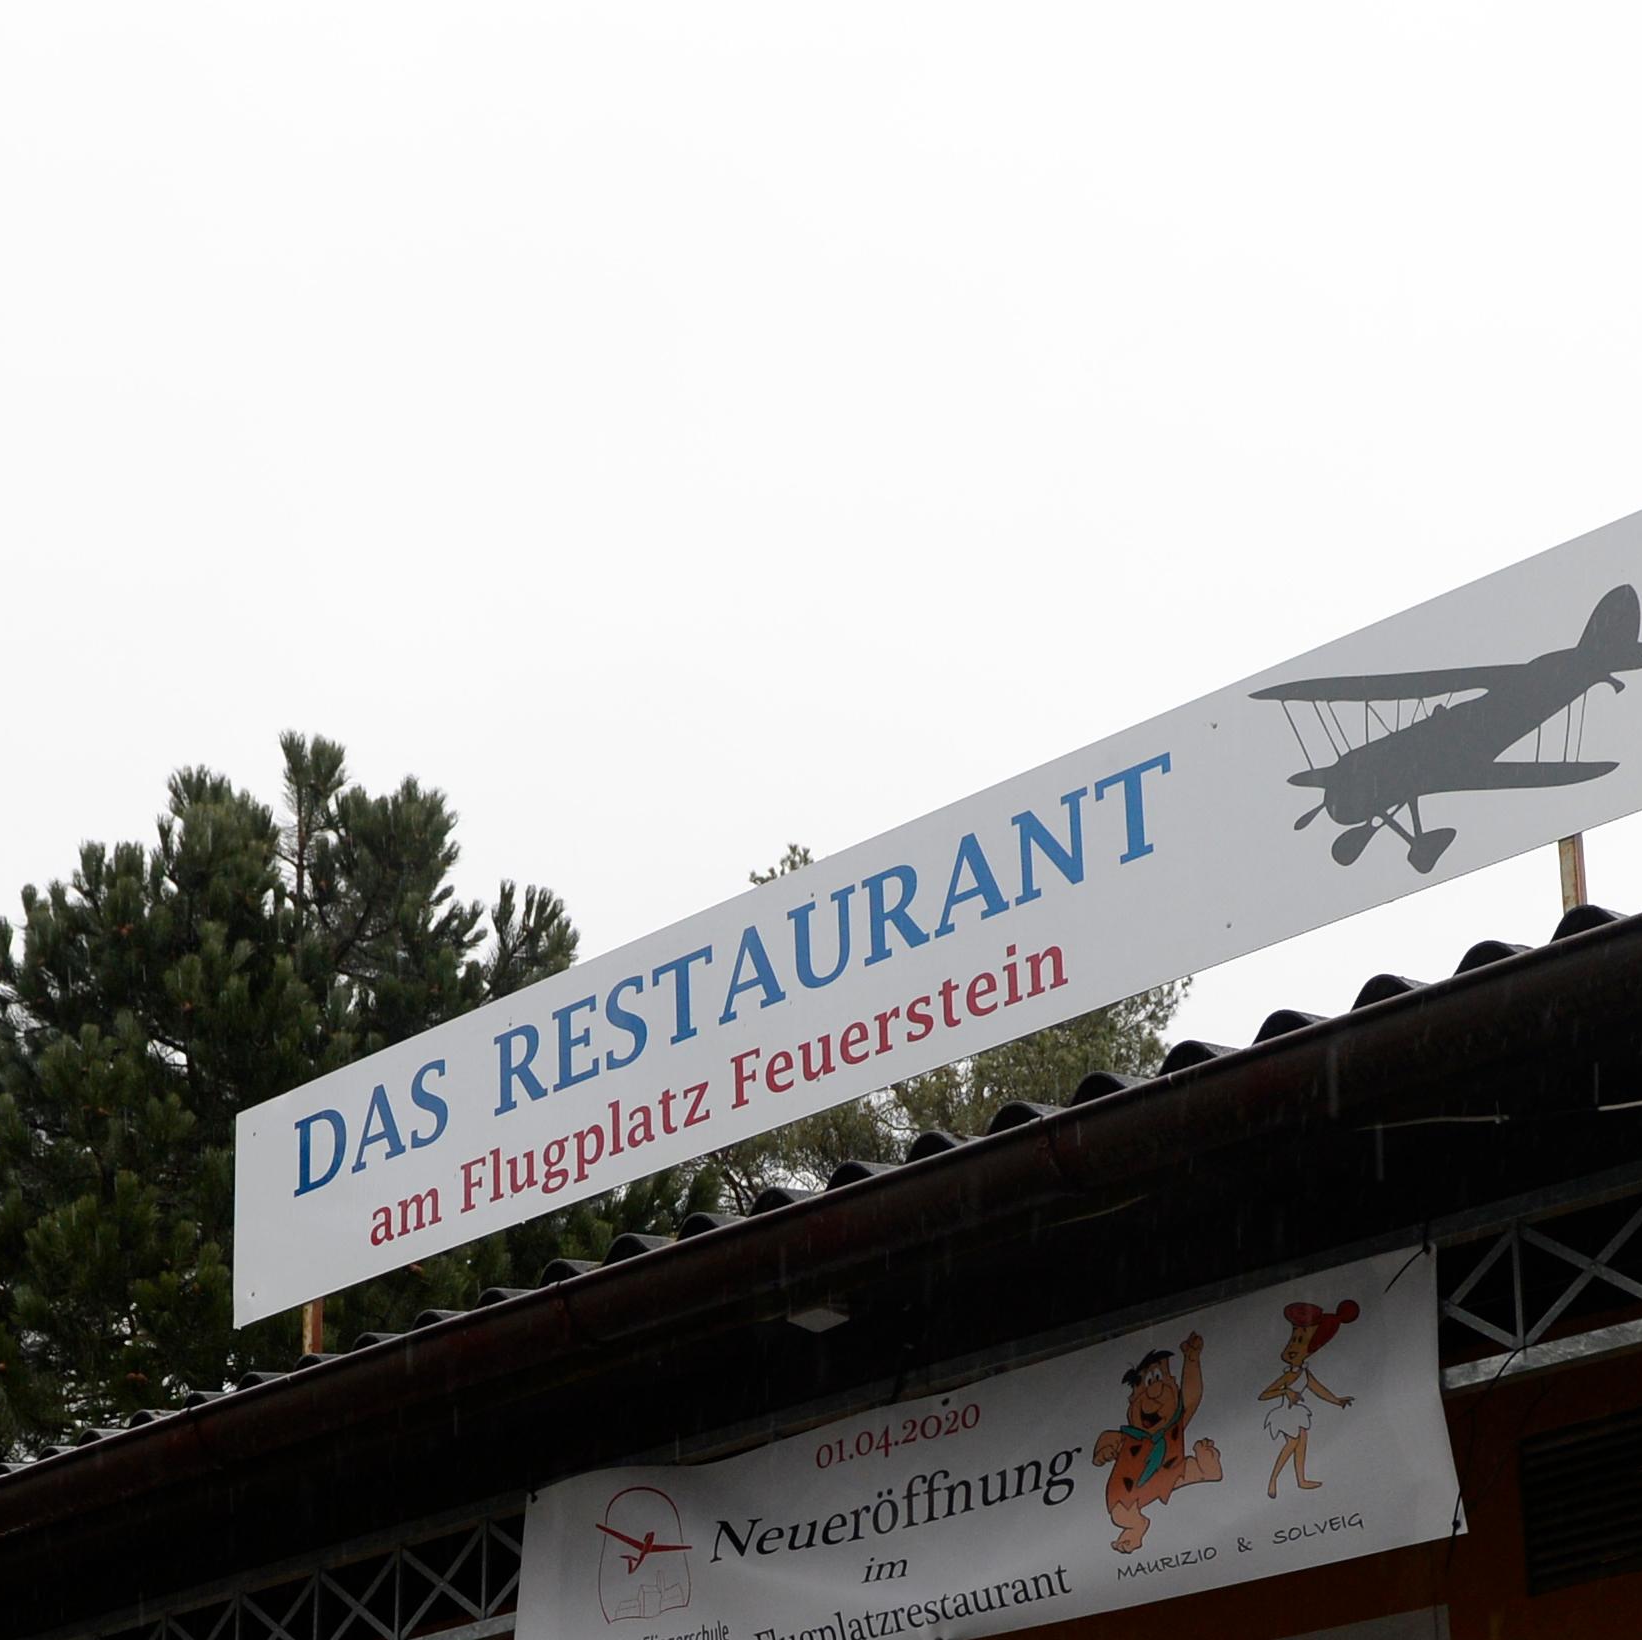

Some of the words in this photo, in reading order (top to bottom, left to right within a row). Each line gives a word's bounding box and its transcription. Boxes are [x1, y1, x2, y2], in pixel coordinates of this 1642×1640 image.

[294, 1059, 449, 1197] DAS
[493, 751, 1172, 1117] RESTAURANT
[370, 1187, 442, 1247] am
[459, 1080, 712, 1214] Flugplatz
[729, 943, 1069, 1110] Feuerstein
[814, 1403, 981, 1470] 01.04.2020
[709, 1445, 1083, 1564] Neueröffnung
[1117, 1546, 1218, 1581] MAURIZIO
[1237, 1536, 1254, 1553] &
[1271, 1512, 1365, 1545] SOLVEIG
[860, 1556, 909, 1585] im
